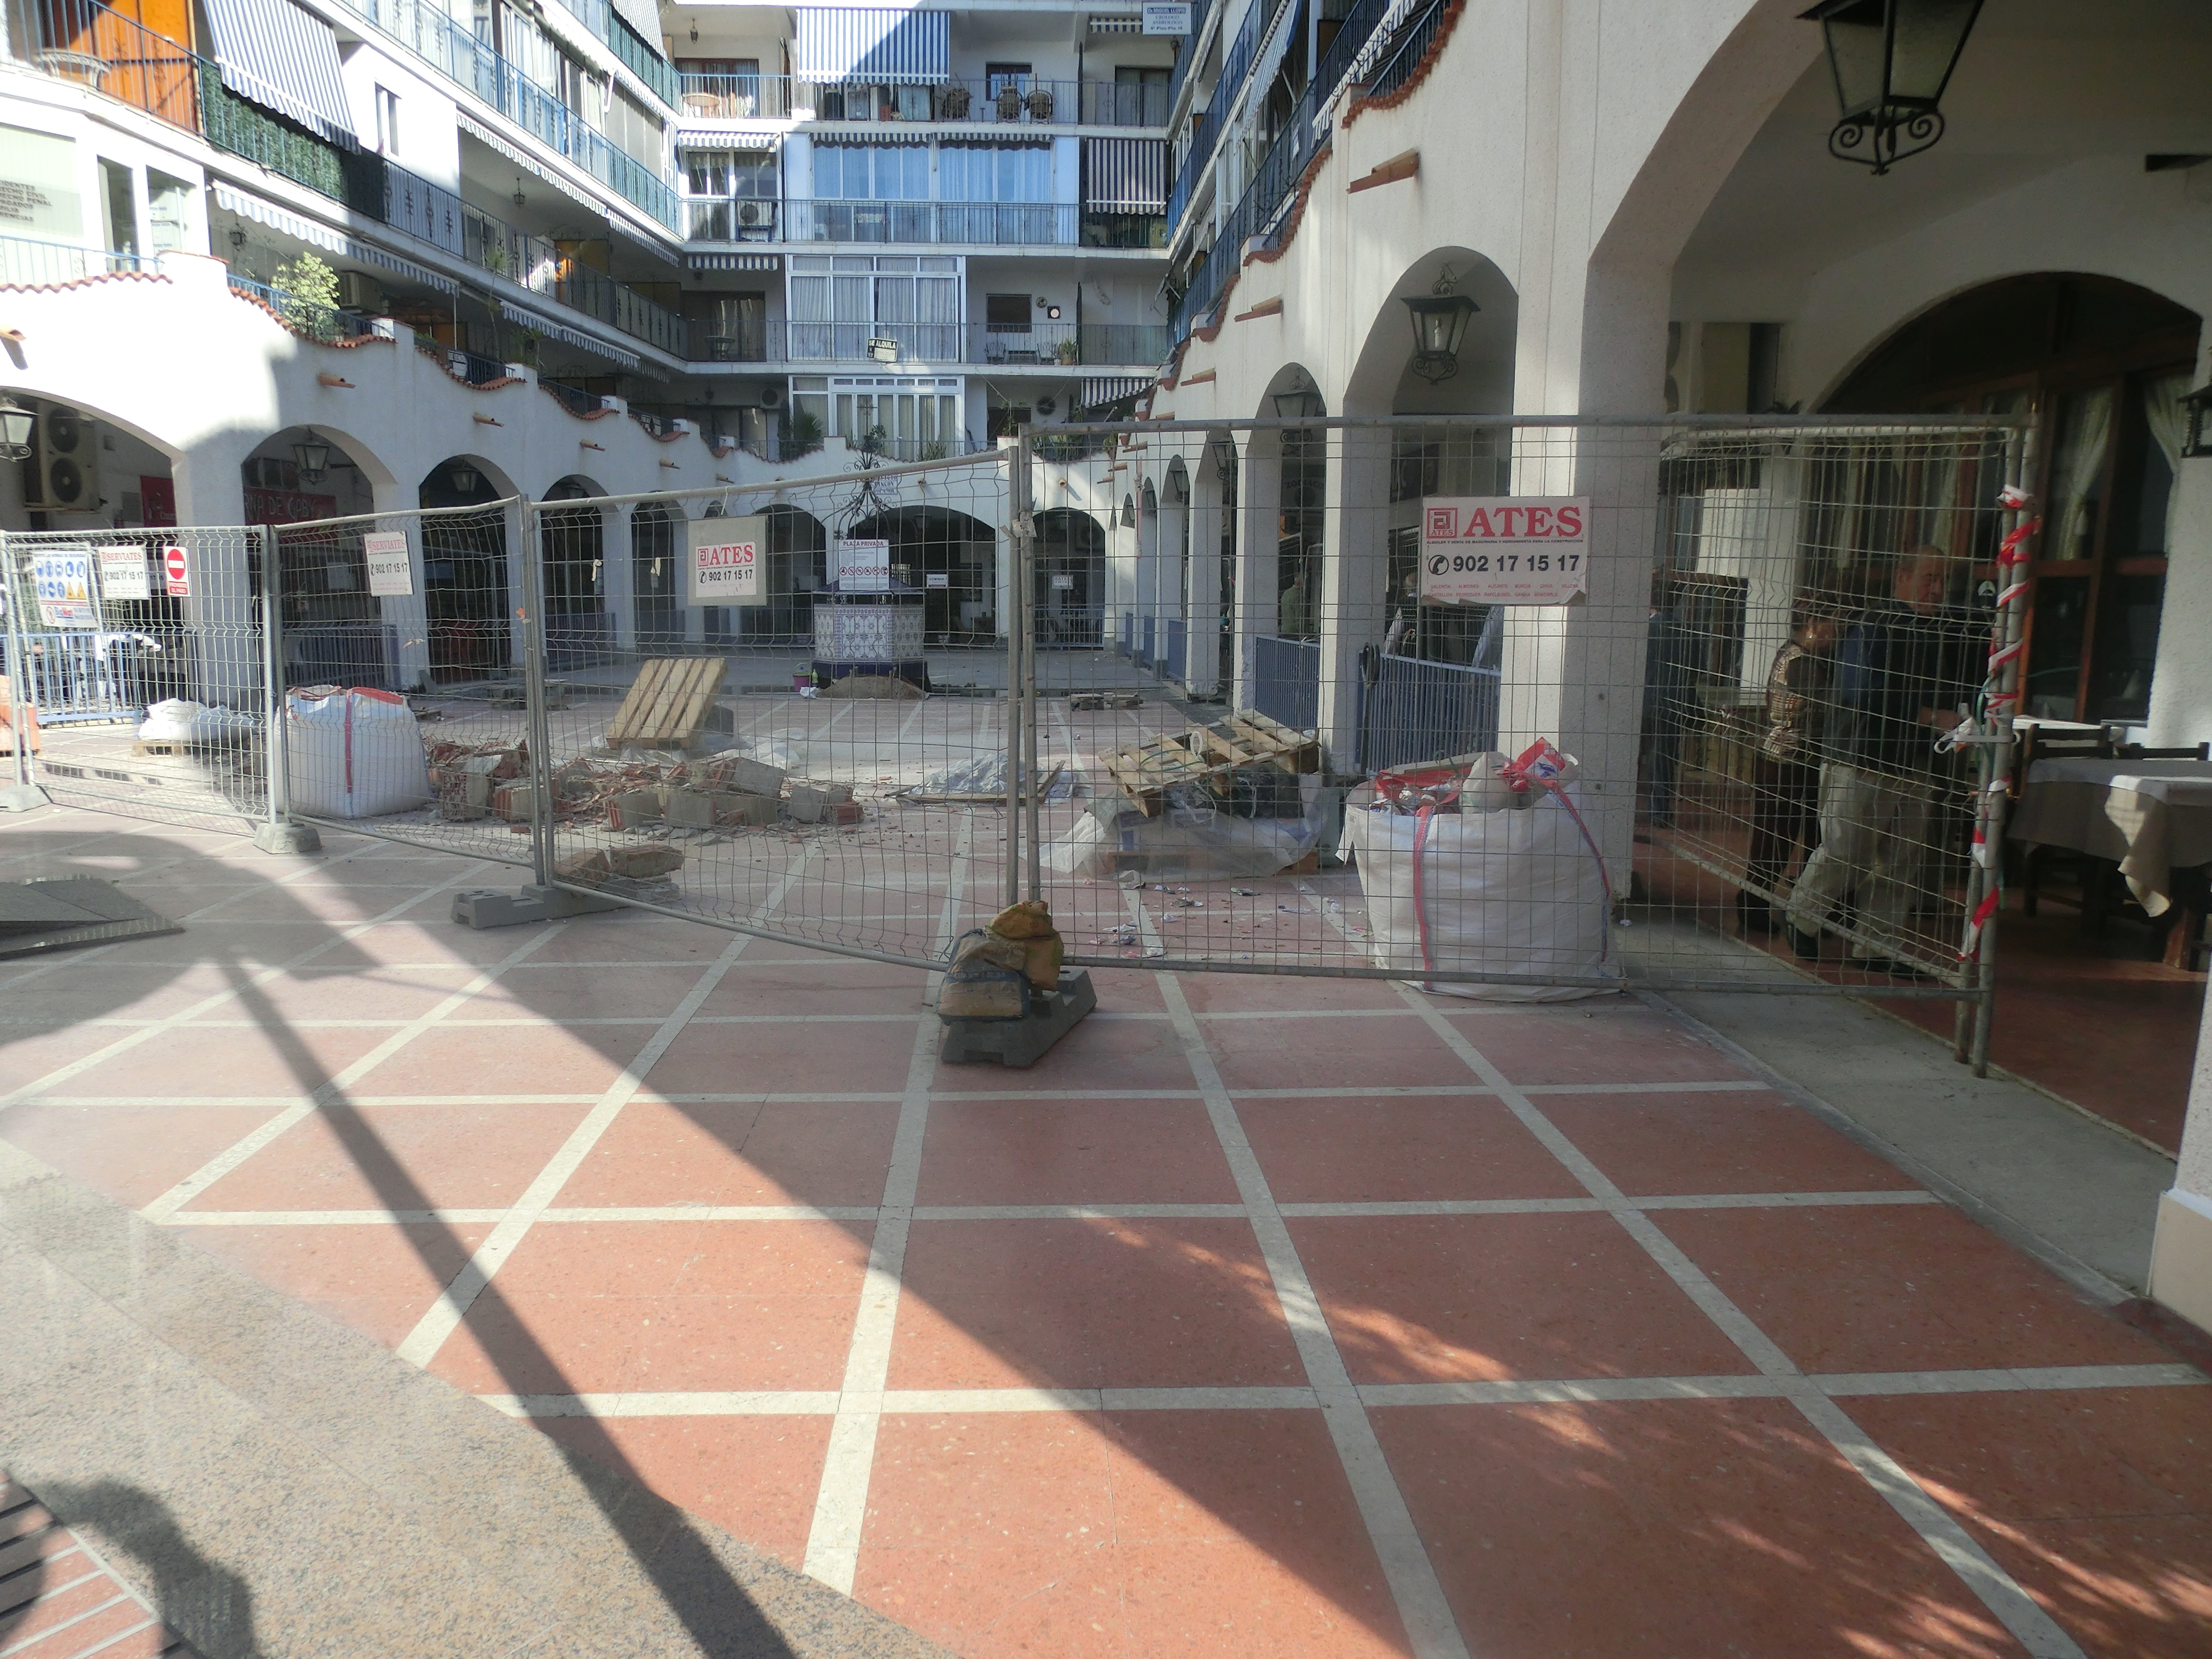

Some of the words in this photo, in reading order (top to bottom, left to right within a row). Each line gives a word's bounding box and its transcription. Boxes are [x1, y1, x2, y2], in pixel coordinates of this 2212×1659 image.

[27, 191, 47, 200] CIVIL
[27, 197, 53, 207] PENAL
[876, 340, 896, 349] ALQUILA
[268, 495, 284, 516] DE
[1463, 506, 1582, 537] ATES
[372, 540, 405, 550] SERVIATES
[107, 553, 143, 561] SERVIATES
[709, 545, 753, 565] ATES
[375, 564, 385, 574] 902
[386, 563, 392, 573] 17
[394, 563, 400, 573] 15
[401, 563, 407, 572] 17
[1453, 555, 1489, 572] 902
[1497, 555, 1518, 571] 17
[1527, 555, 1549, 571] 15
[1558, 555, 1579, 571] 17
[109, 572, 120, 580] 902
[709, 571, 721, 581] 902
[724, 571, 731, 580] 17
[734, 570, 742, 579] 15
[745, 569, 753, 579] 17
